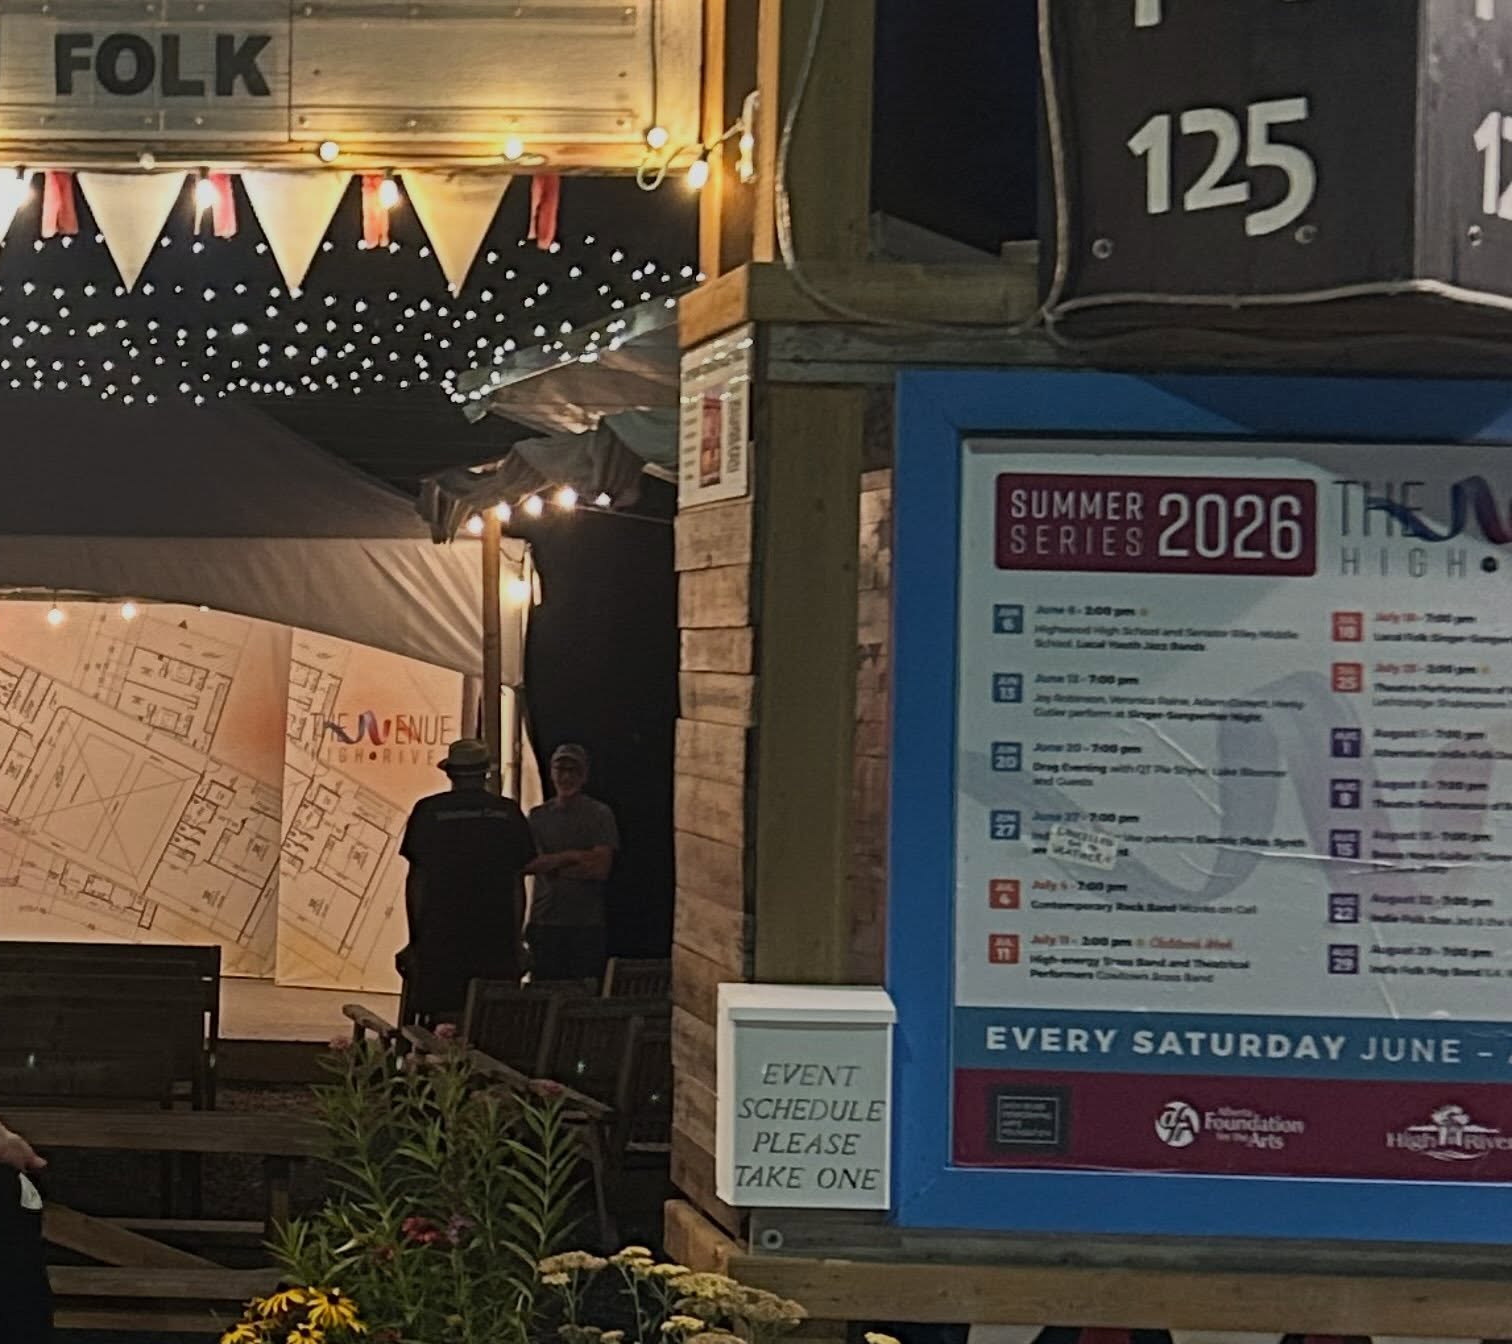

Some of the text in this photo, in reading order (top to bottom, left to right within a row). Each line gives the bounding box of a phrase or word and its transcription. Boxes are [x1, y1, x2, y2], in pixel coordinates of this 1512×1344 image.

[53, 30, 273, 97] FOLK
[1126, 97, 1317, 237] 125
[1010, 489, 1144, 521] SUMMER
[1332, 480, 1426, 538] THE
[1158, 493, 1302, 561] 2026
[1010, 524, 1144, 557] SERIES
[1340, 547, 1467, 579] HIGH
[1114, 608, 1136, 618] pm
[1454, 616, 1477, 625] pm
[1002, 618, 1015, 631] 6
[1454, 666, 1477, 676] pm
[1117, 677, 1139, 687] pm
[999, 687, 1016, 700] 13
[383, 748, 435, 767] RIVE
[1120, 746, 1142, 755] pm
[995, 755, 1017, 769] 20
[1118, 815, 1140, 824] pm
[994, 824, 1016, 838] 27
[1106, 883, 1128, 893] pm
[1334, 906, 1354, 920] 22
[1110, 938, 1132, 949] pm
[996, 947, 1010, 961] 11
[1333, 957, 1355, 971] 29
[986, 1025, 1118, 1054] EVERY
[1132, 1030, 1347, 1061] SATURDAY
[1360, 1036, 1462, 1064] JUNE
[762, 1063, 862, 1087] EVENT
[738, 1097, 886, 1123] SCHEDULE
[1204, 1112, 1304, 1134] Foundation
[752, 1131, 862, 1156] PLEASE
[1251, 1132, 1284, 1150] Arts
[1386, 1132, 1511, 1152] High Rive
[735, 1165, 880, 1191] TAKE ONE
